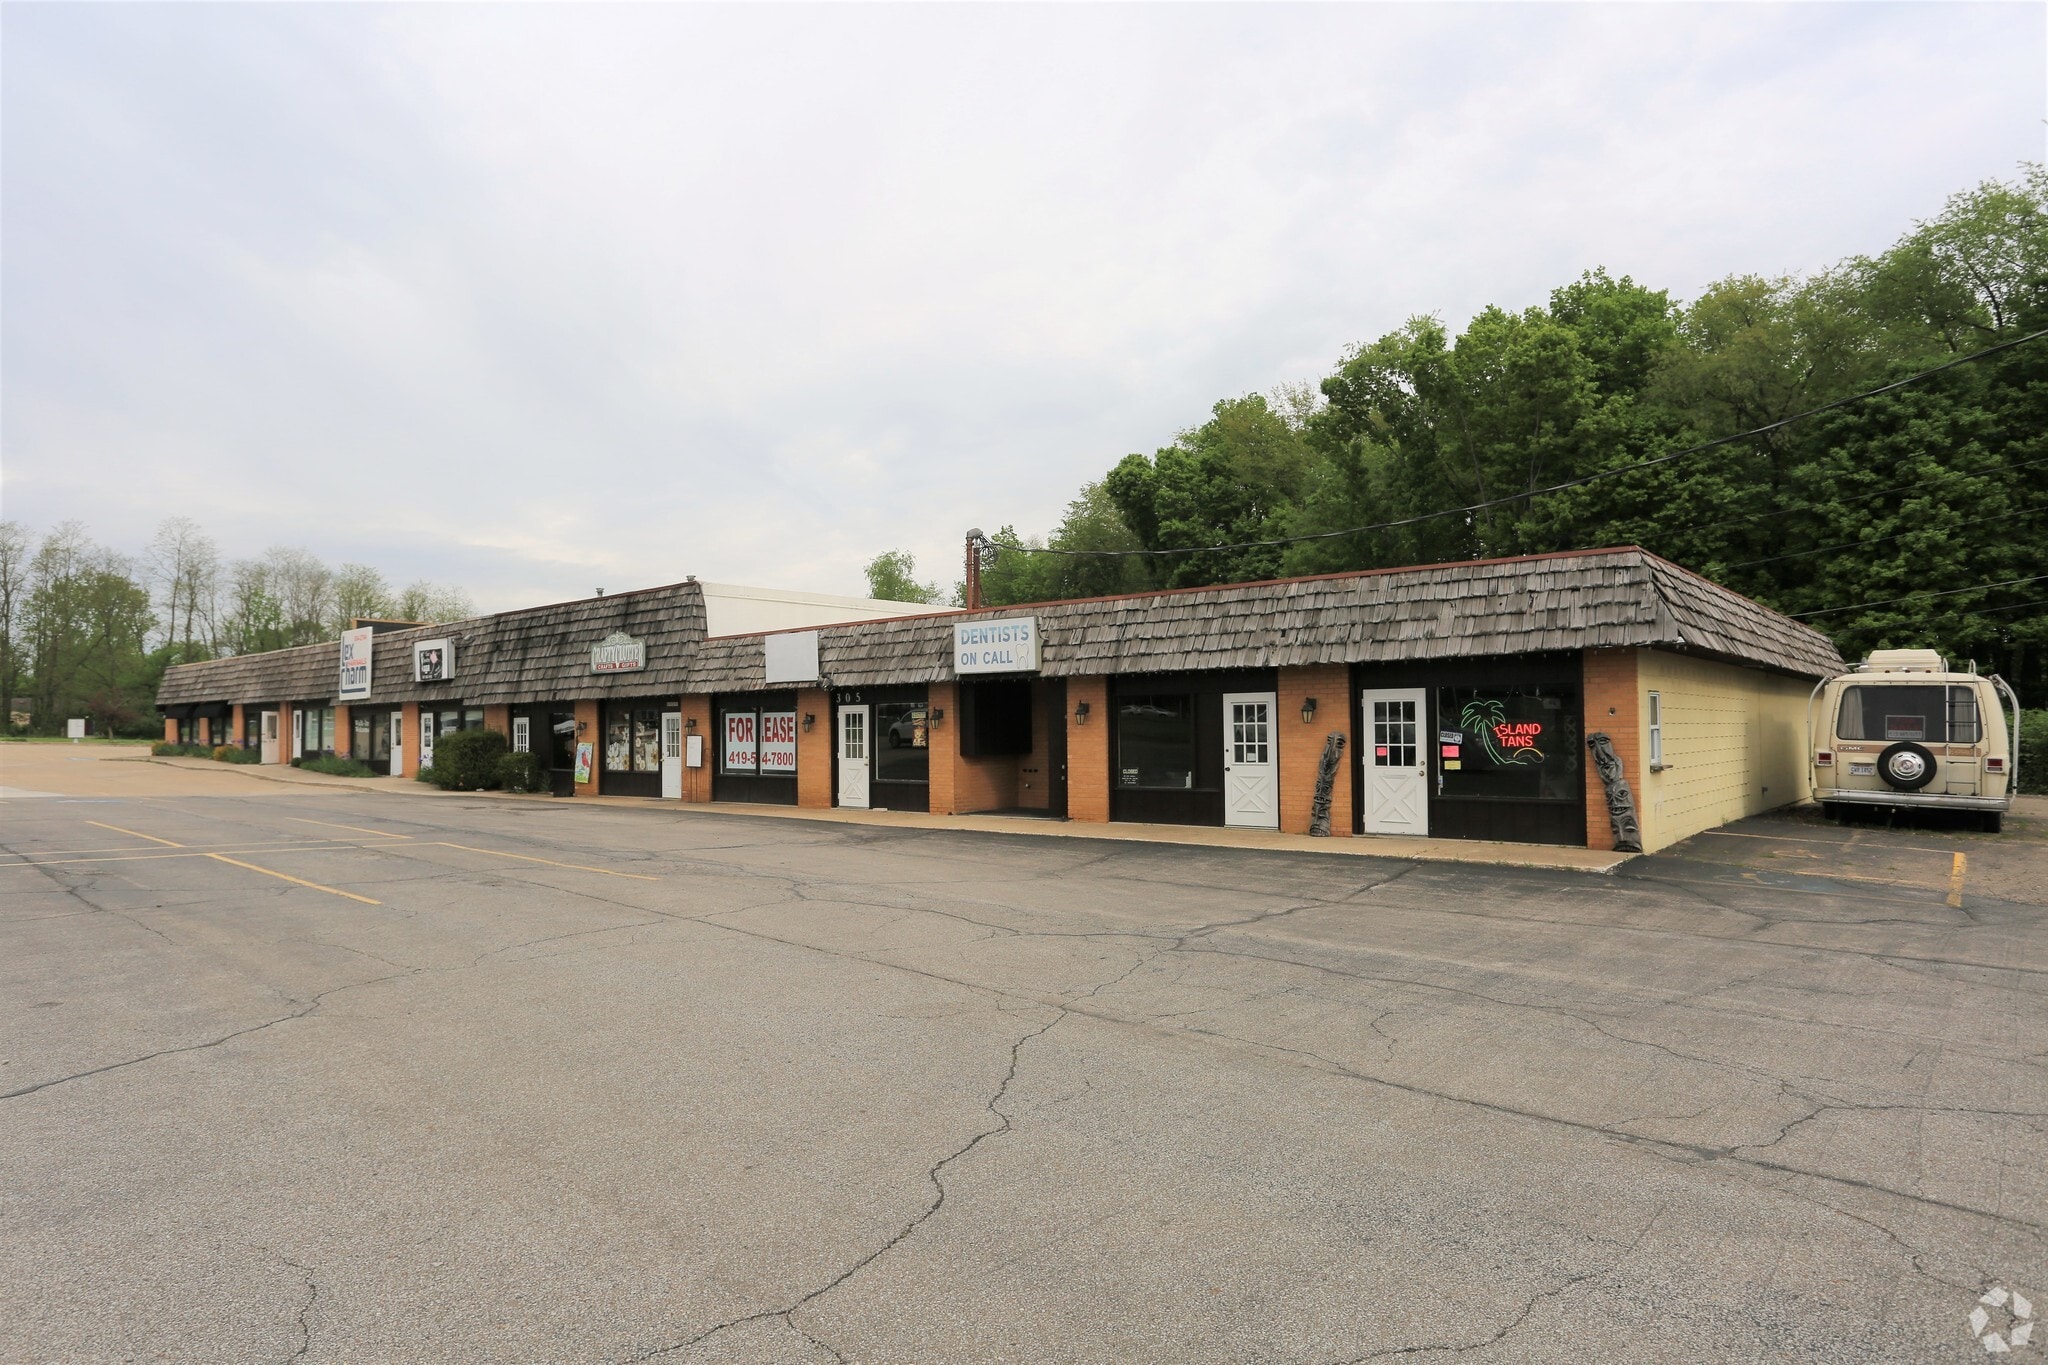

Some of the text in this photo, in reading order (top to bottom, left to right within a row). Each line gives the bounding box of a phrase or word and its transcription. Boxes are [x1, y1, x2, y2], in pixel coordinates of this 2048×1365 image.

[961, 624, 1029, 645] DENTISTS
[961, 650, 1013, 666] ON CALL
[836, 692, 861, 703] 305
[728, 717, 754, 743] FOR
[1493, 723, 1541, 738] ISLAND
[1500, 735, 1533, 747] TANS
[728, 751, 794, 766] 419-54-7800
